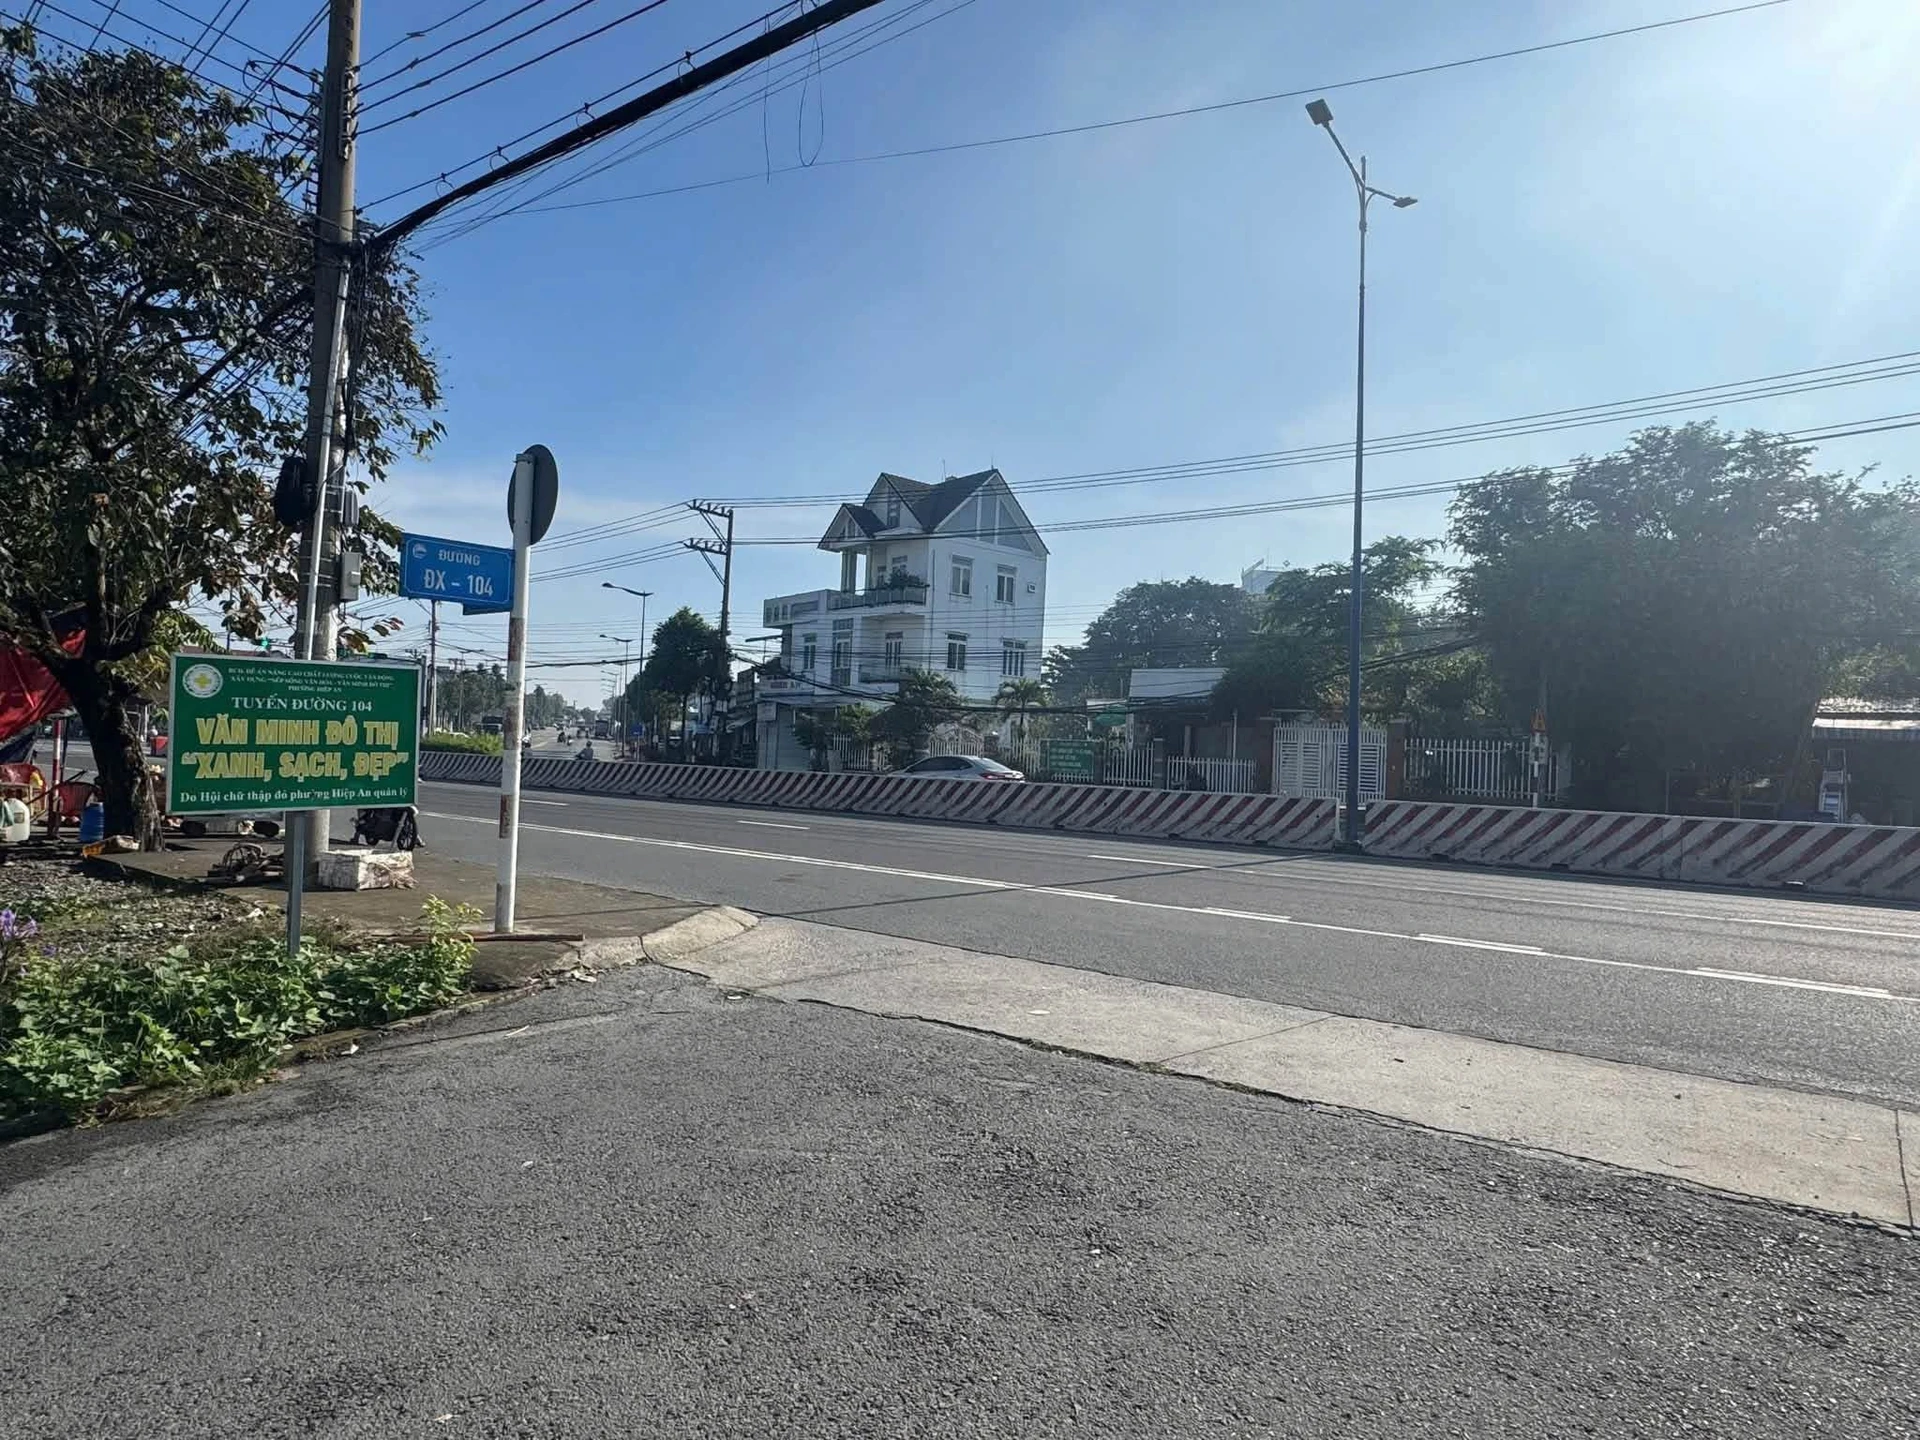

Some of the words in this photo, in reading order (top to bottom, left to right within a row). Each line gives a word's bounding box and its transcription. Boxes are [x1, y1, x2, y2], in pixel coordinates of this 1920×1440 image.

[423, 568, 446, 591] ĐX
[466, 574, 494, 597] 104
[231, 692, 288, 710] TUYẾN
[291, 697, 347, 711] ĐƯỜNG
[351, 700, 373, 712] 104
[195, 713, 249, 745] VĂN
[255, 718, 320, 745] MINH
[325, 715, 358, 745] ĐÔ
[363, 721, 399, 750] THỊ
[278, 751, 348, 783] SẠCH,
[180, 792, 197, 803] Do
[201, 790, 221, 804] Hội
[223, 789, 245, 802] chữ
[248, 789, 272, 803] thập
[274, 789, 288, 801] đỏ
[332, 787, 356, 801] Hiệp
[357, 788, 373, 798] An
[373, 786, 397, 800] quản
